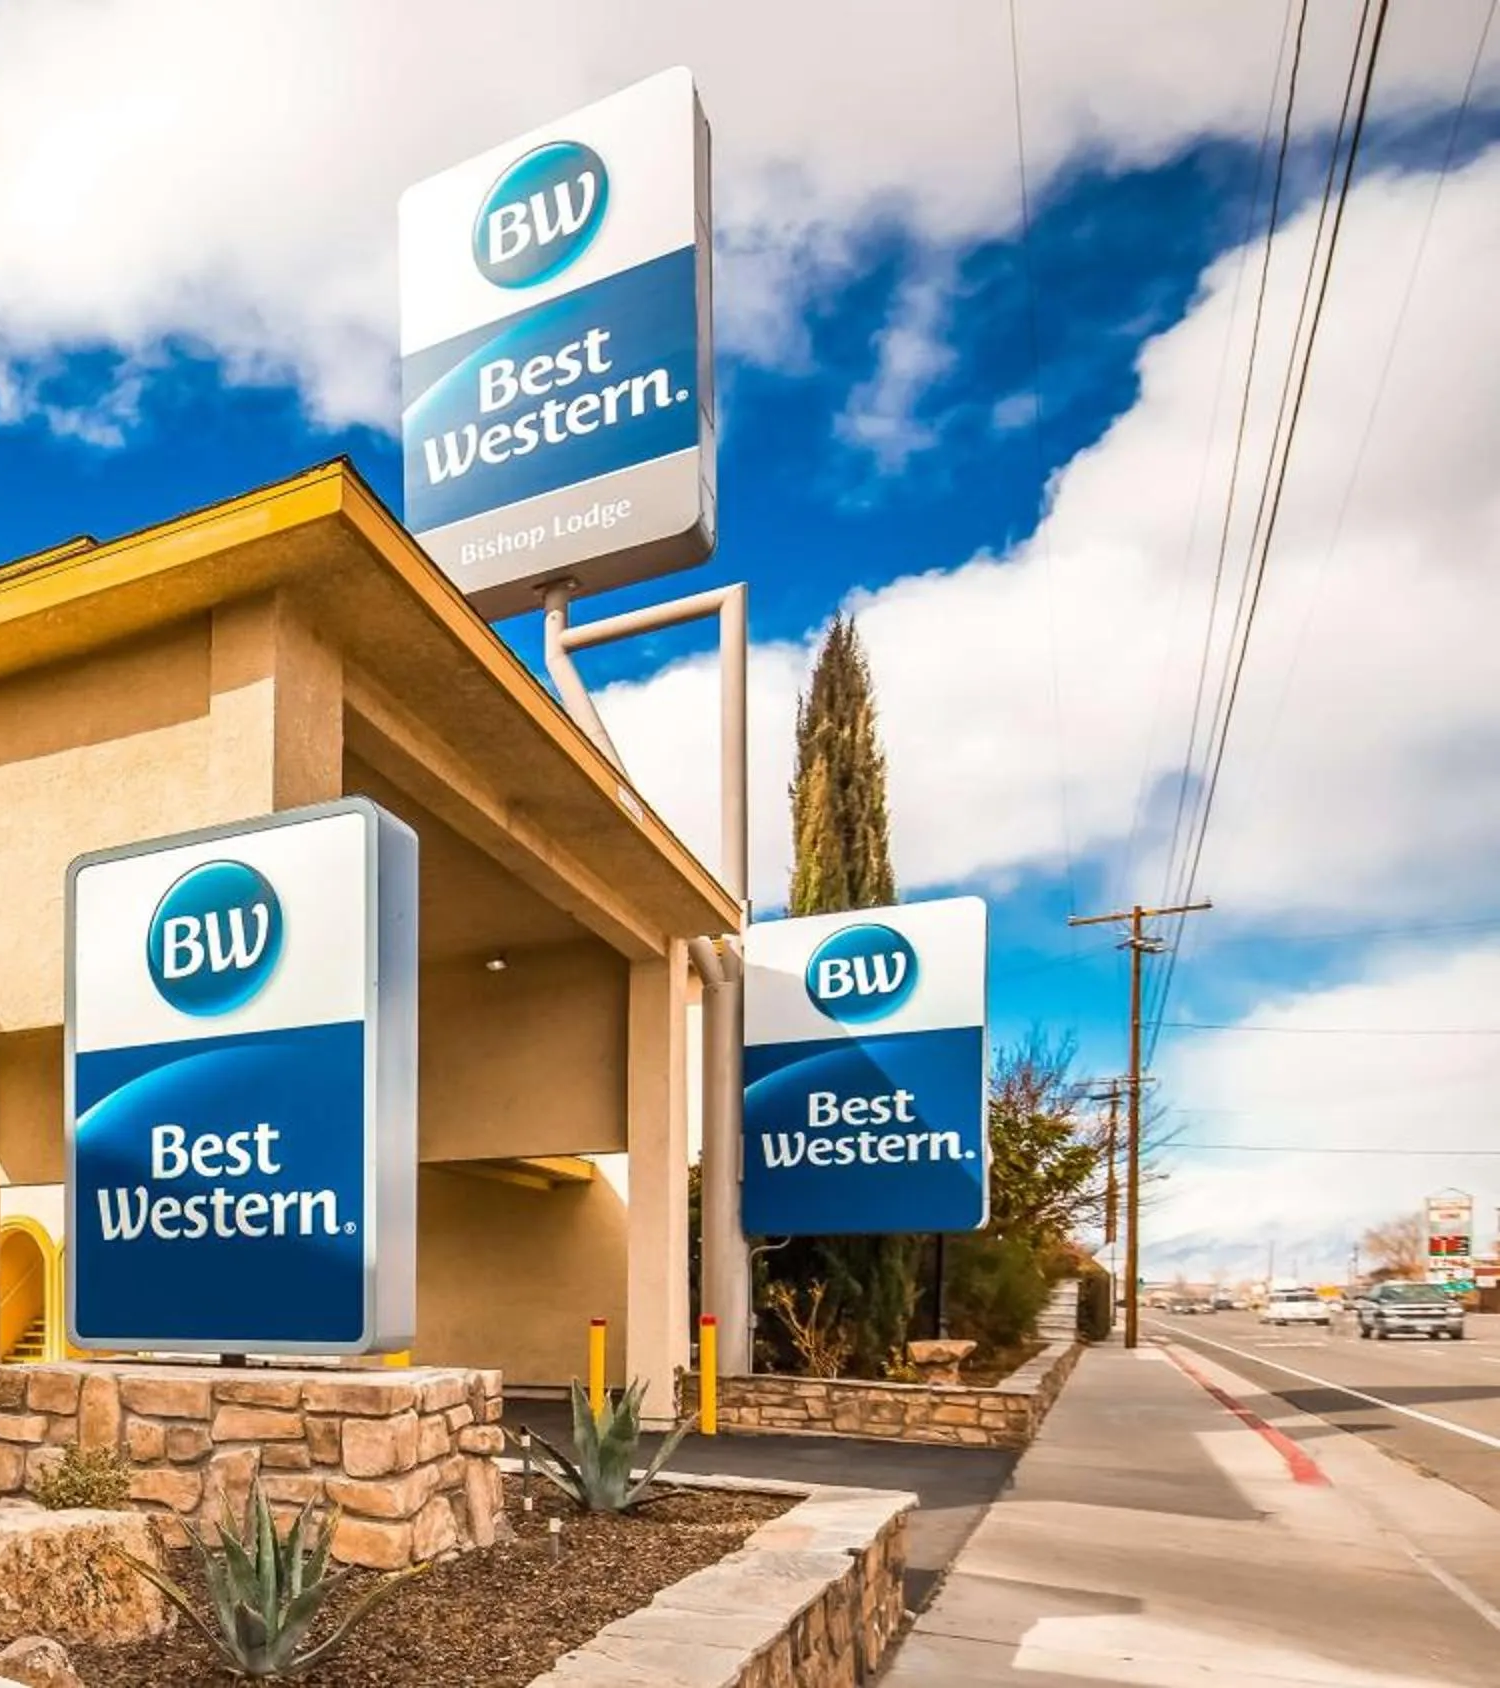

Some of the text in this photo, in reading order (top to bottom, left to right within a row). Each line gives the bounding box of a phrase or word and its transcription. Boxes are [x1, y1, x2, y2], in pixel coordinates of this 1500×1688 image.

[486, 170, 596, 265] BW
[478, 327, 612, 414] Best
[460, 495, 632, 566] Bishop Lodge
[162, 901, 269, 979] BW
[817, 951, 907, 999] BW
[807, 1089, 916, 1127] Best
[150, 1122, 281, 1180] Best
